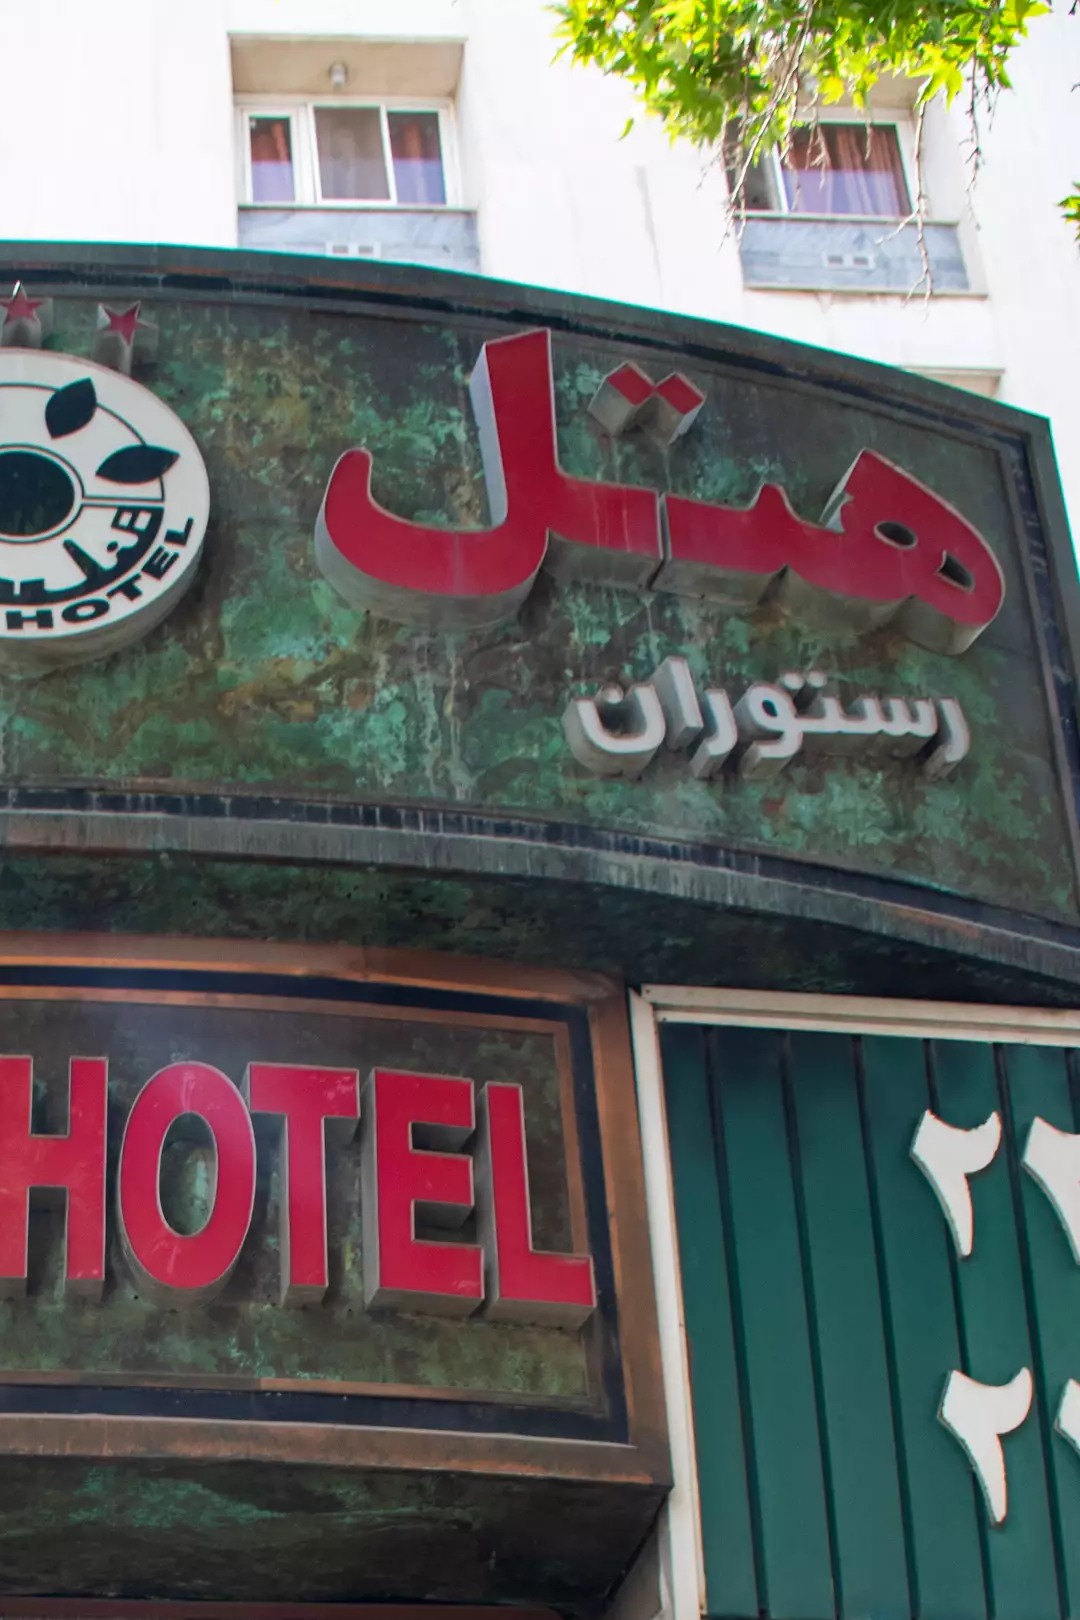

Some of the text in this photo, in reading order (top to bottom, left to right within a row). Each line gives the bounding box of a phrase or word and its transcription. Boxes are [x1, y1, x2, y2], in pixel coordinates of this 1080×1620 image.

[314, 327, 1006, 650] هتل
[5, 517, 195, 631] HOTEL
[563, 656, 972, 778] رستوران
